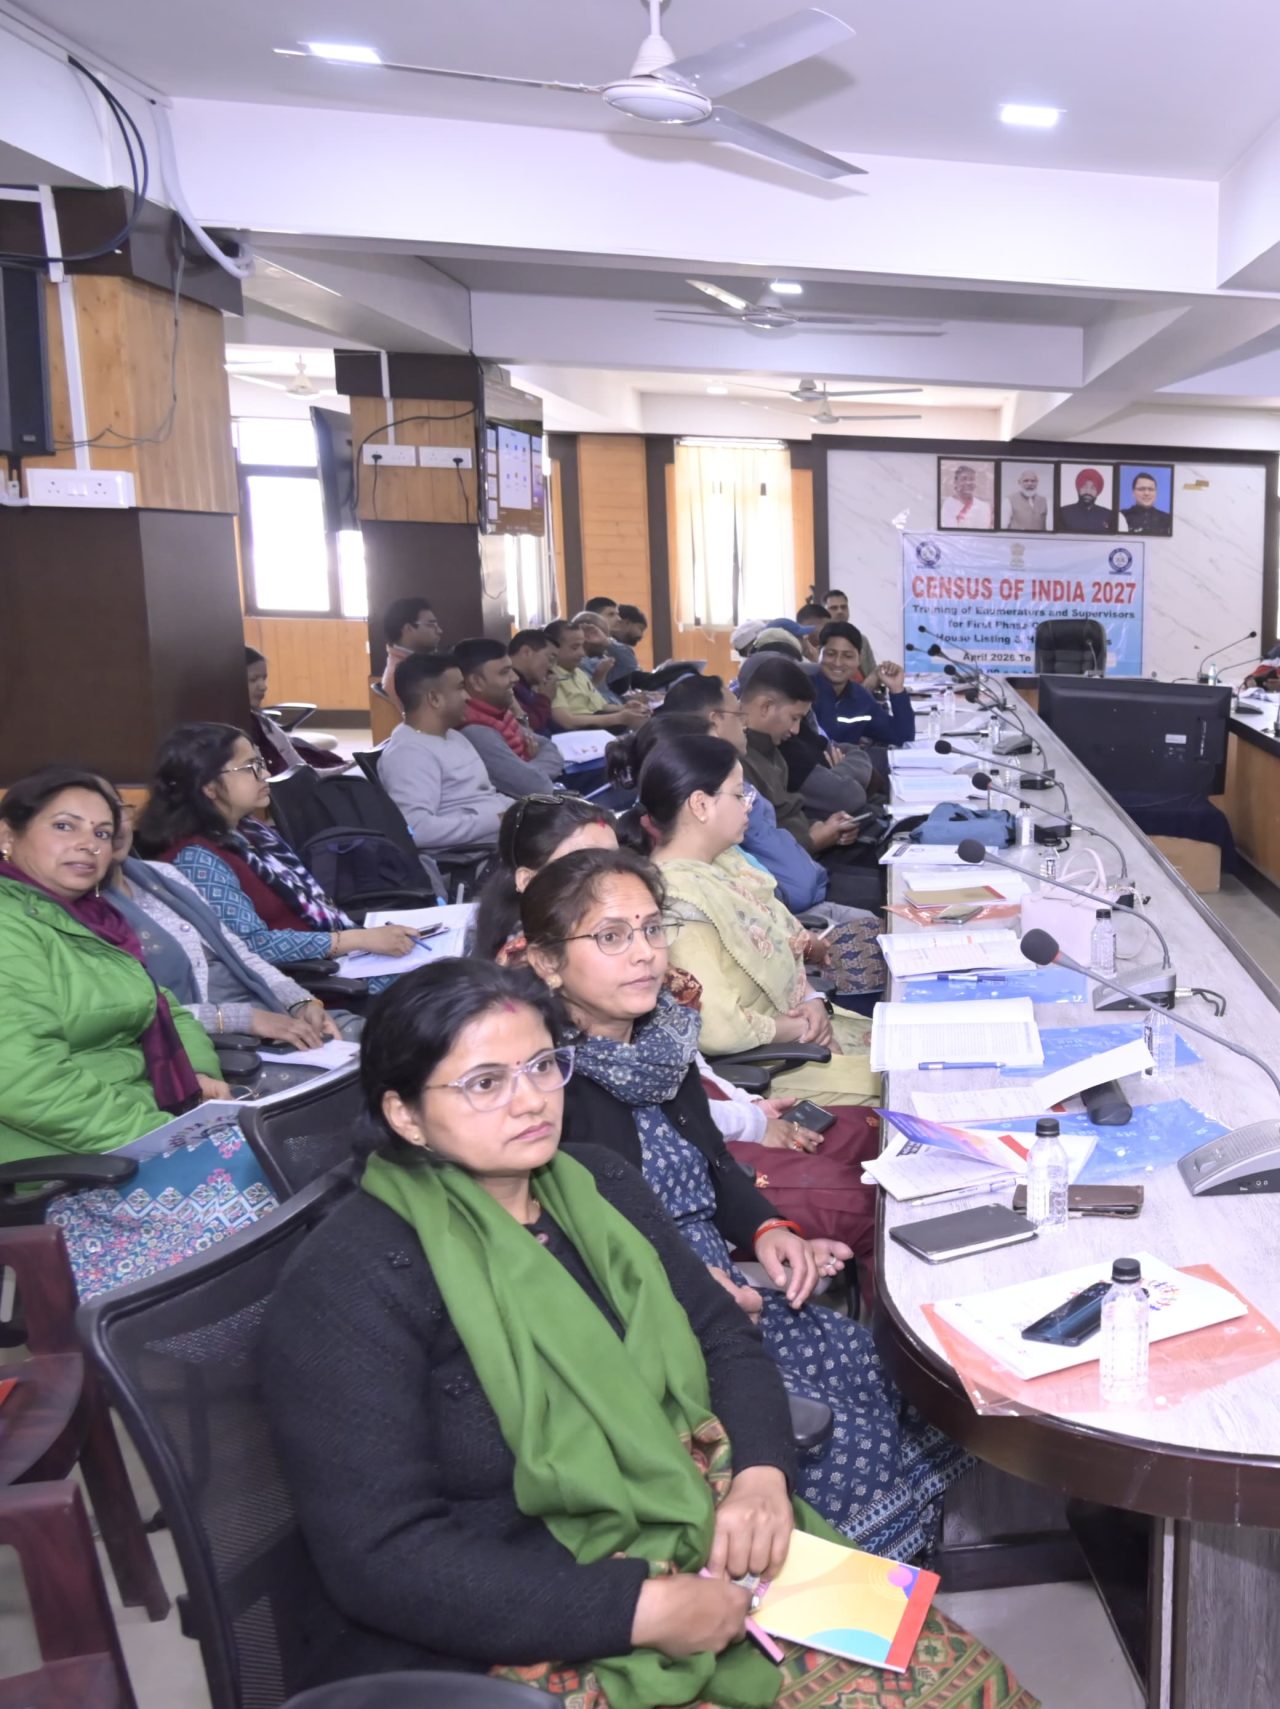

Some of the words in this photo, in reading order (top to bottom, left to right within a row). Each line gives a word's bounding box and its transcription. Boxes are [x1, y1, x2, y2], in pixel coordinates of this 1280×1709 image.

[911, 575, 993, 600] CENSUS
[999, 578, 1024, 601] OF
[1031, 579, 1085, 603] INDIA
[1091, 581, 1136, 604] 2027
[961, 605, 972, 615] of
[1048, 608, 1068, 617] and
[1071, 608, 1135, 620] Supervisors
[974, 633, 1011, 645] Listing
[963, 652, 987, 663] April
[1018, 653, 1032, 662] To
